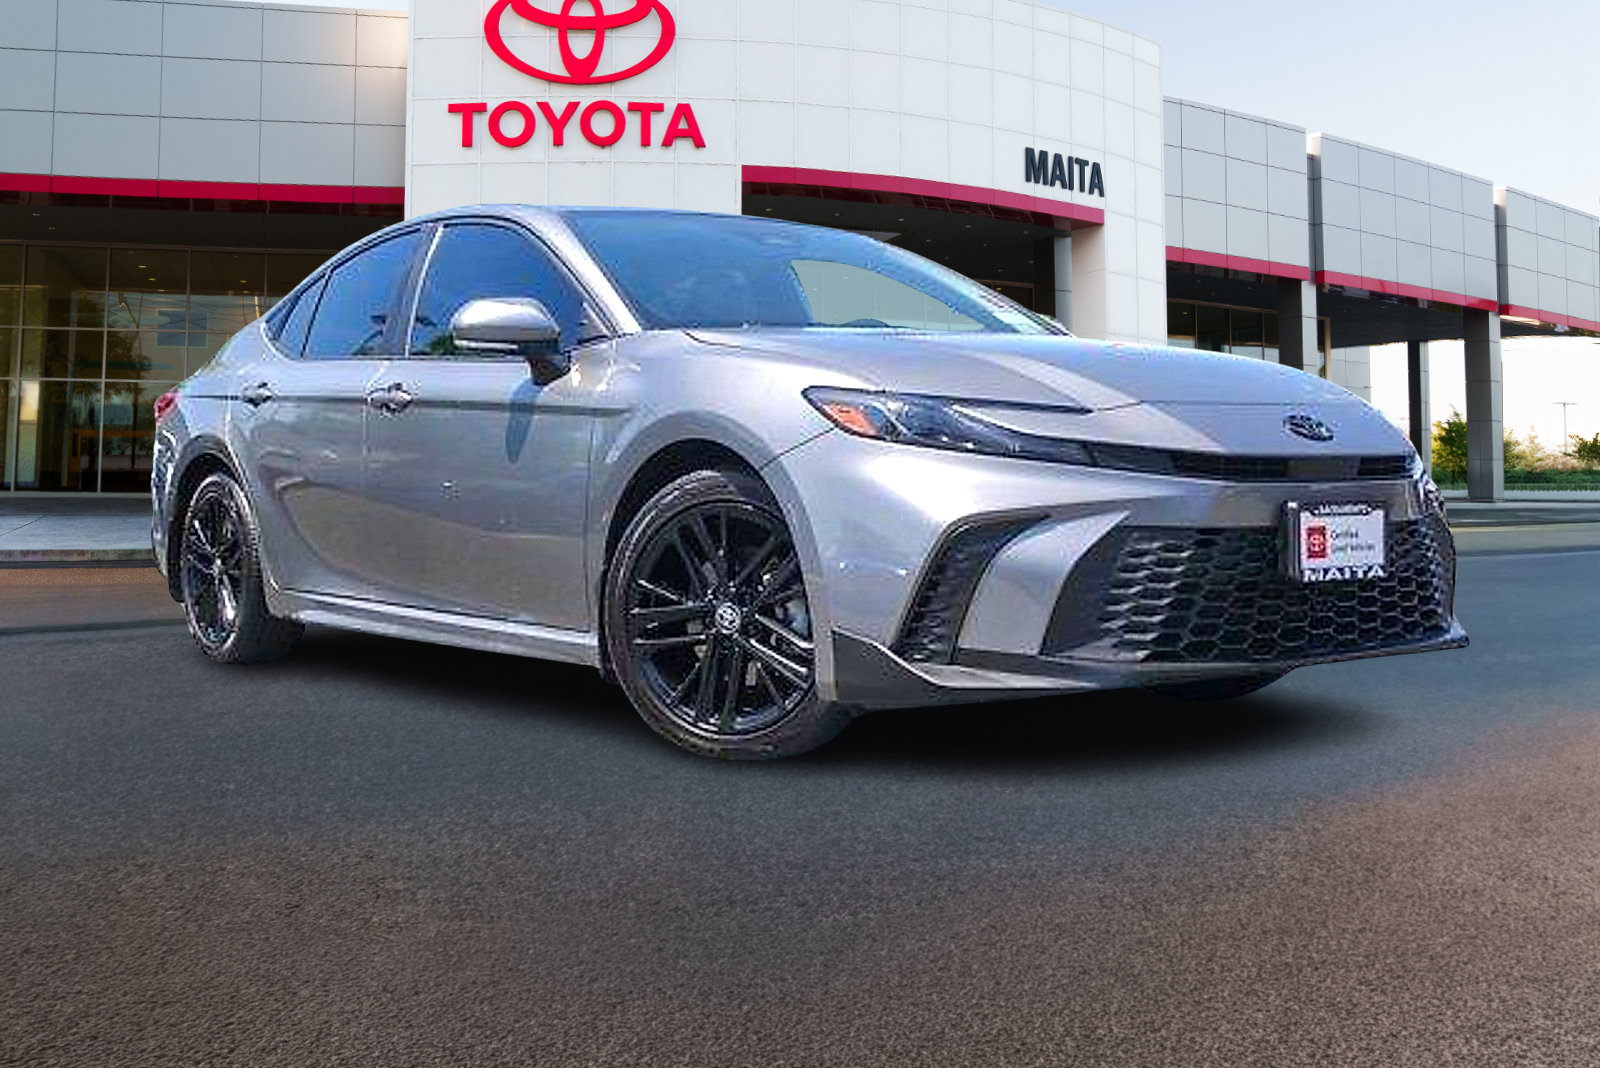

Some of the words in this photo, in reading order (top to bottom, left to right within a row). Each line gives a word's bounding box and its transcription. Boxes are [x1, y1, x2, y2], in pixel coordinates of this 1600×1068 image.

[448, 100, 706, 148] TOYOTA
[1025, 147, 1104, 197] MAITA
[1303, 564, 1385, 582] MAITA
